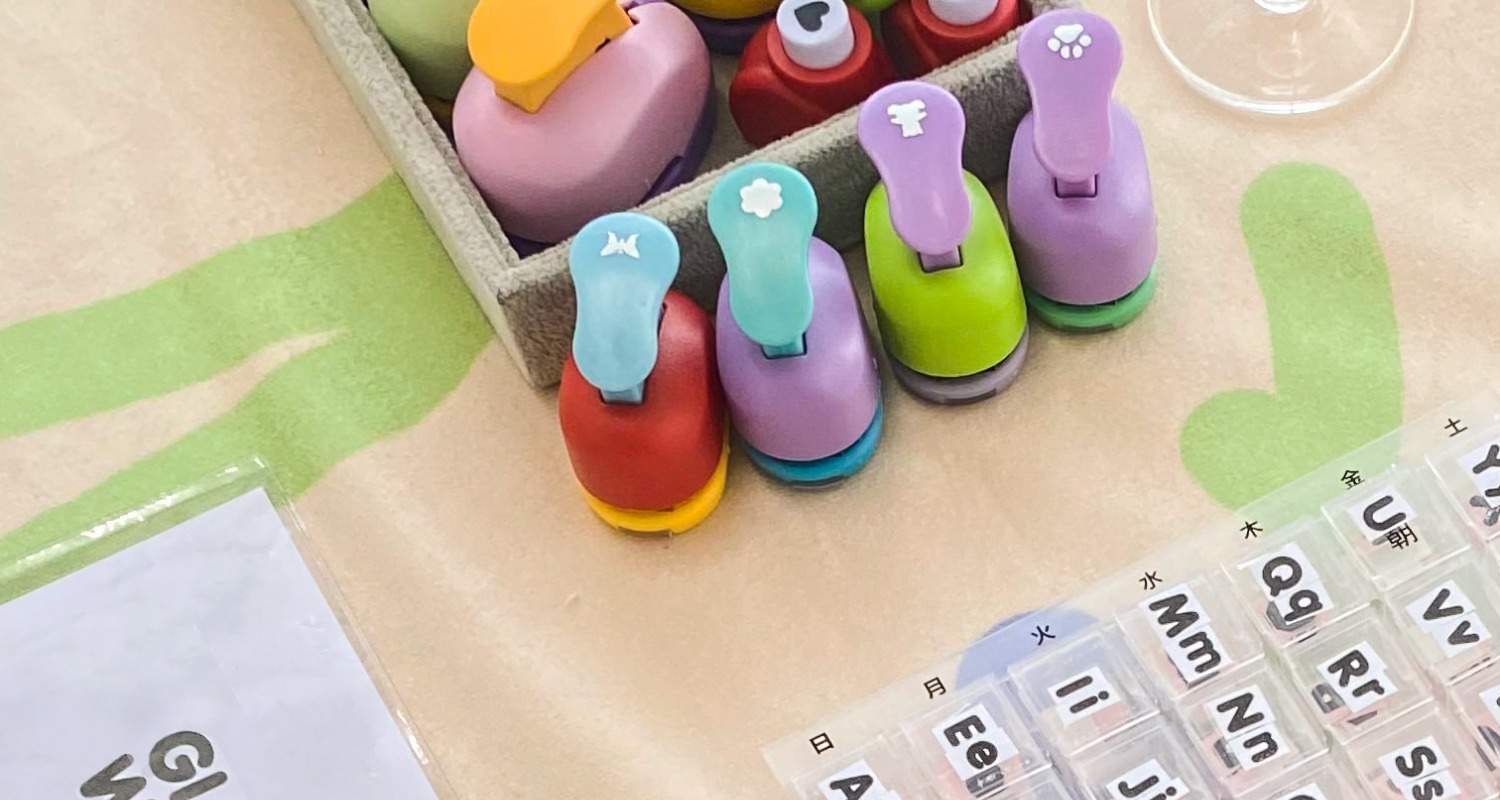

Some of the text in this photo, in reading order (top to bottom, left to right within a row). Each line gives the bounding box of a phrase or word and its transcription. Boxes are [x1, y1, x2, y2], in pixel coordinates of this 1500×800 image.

[1363, 495, 1407, 531] U
[1386, 522, 1418, 550] 朝
[809, 418, 1468, 754] 日 月 火 水 木 金 土
[1261, 556, 1324, 622] Qq
[1149, 594, 1221, 673] Mm
[1423, 588, 1480, 646] Vv
[1327, 649, 1385, 698] Rr
[943, 715, 998, 770] Ee
[1216, 692, 1278, 763] Nn
[1395, 746, 1444, 800] Ss
